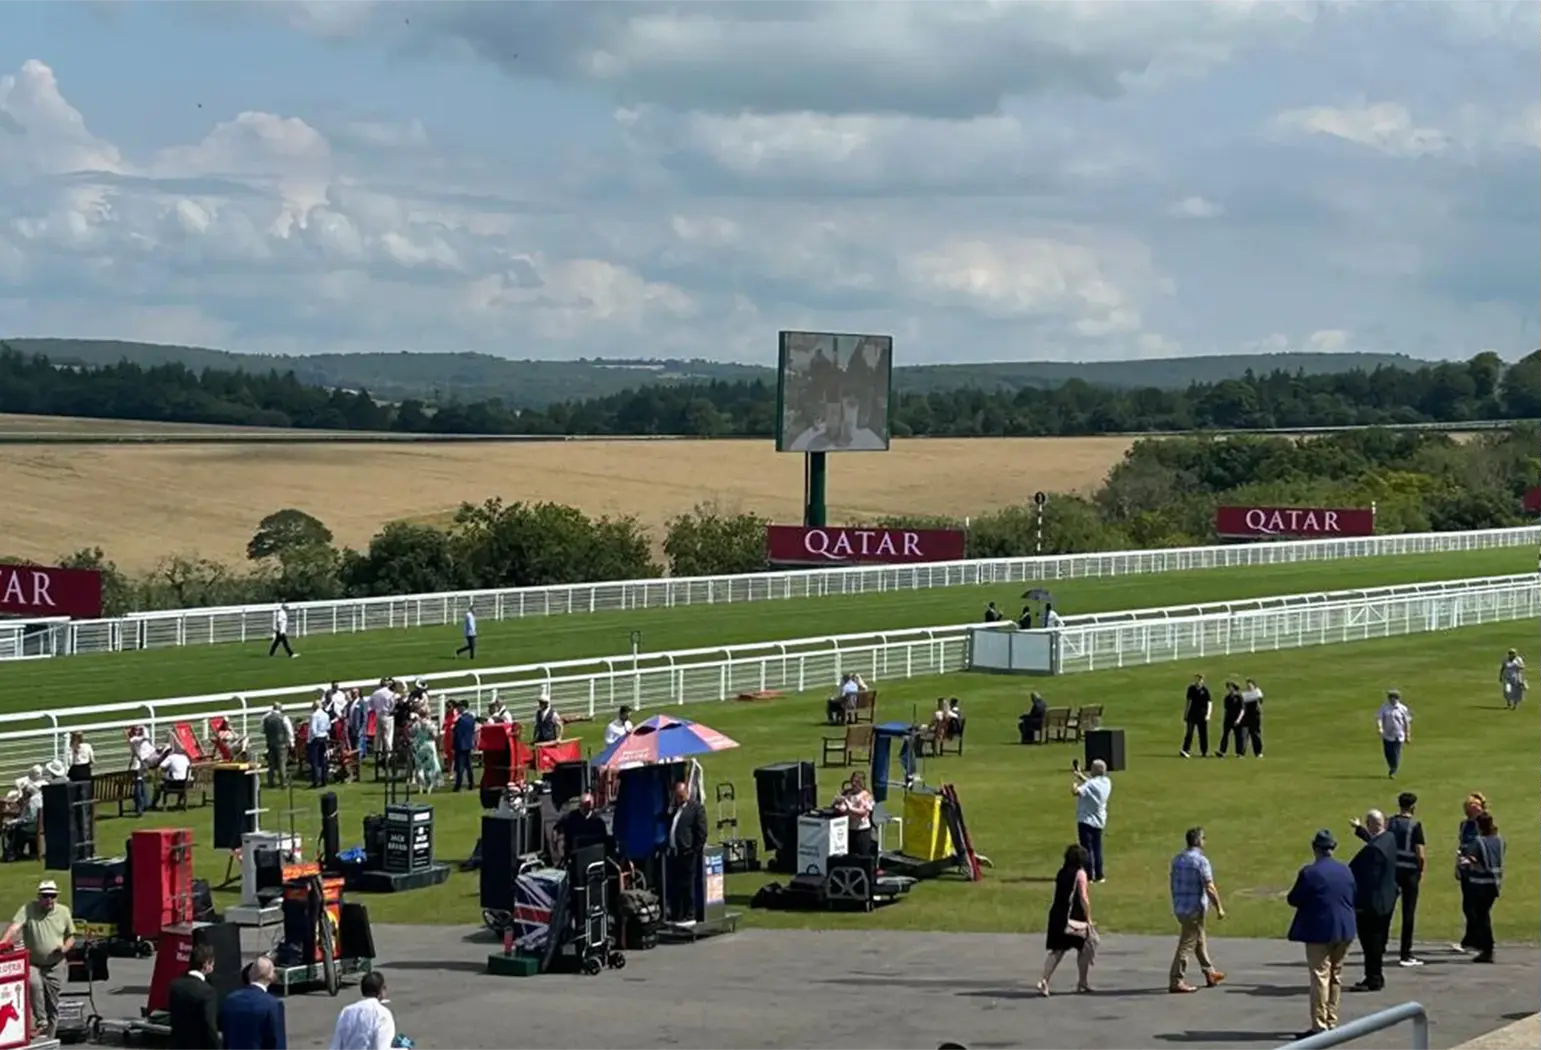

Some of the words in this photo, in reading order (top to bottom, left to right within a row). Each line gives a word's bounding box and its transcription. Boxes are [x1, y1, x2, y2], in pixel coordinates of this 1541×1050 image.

[1245, 509, 1341, 534] QATAR
[804, 529, 924, 560] QATAR
[0, 570, 56, 606] AR
